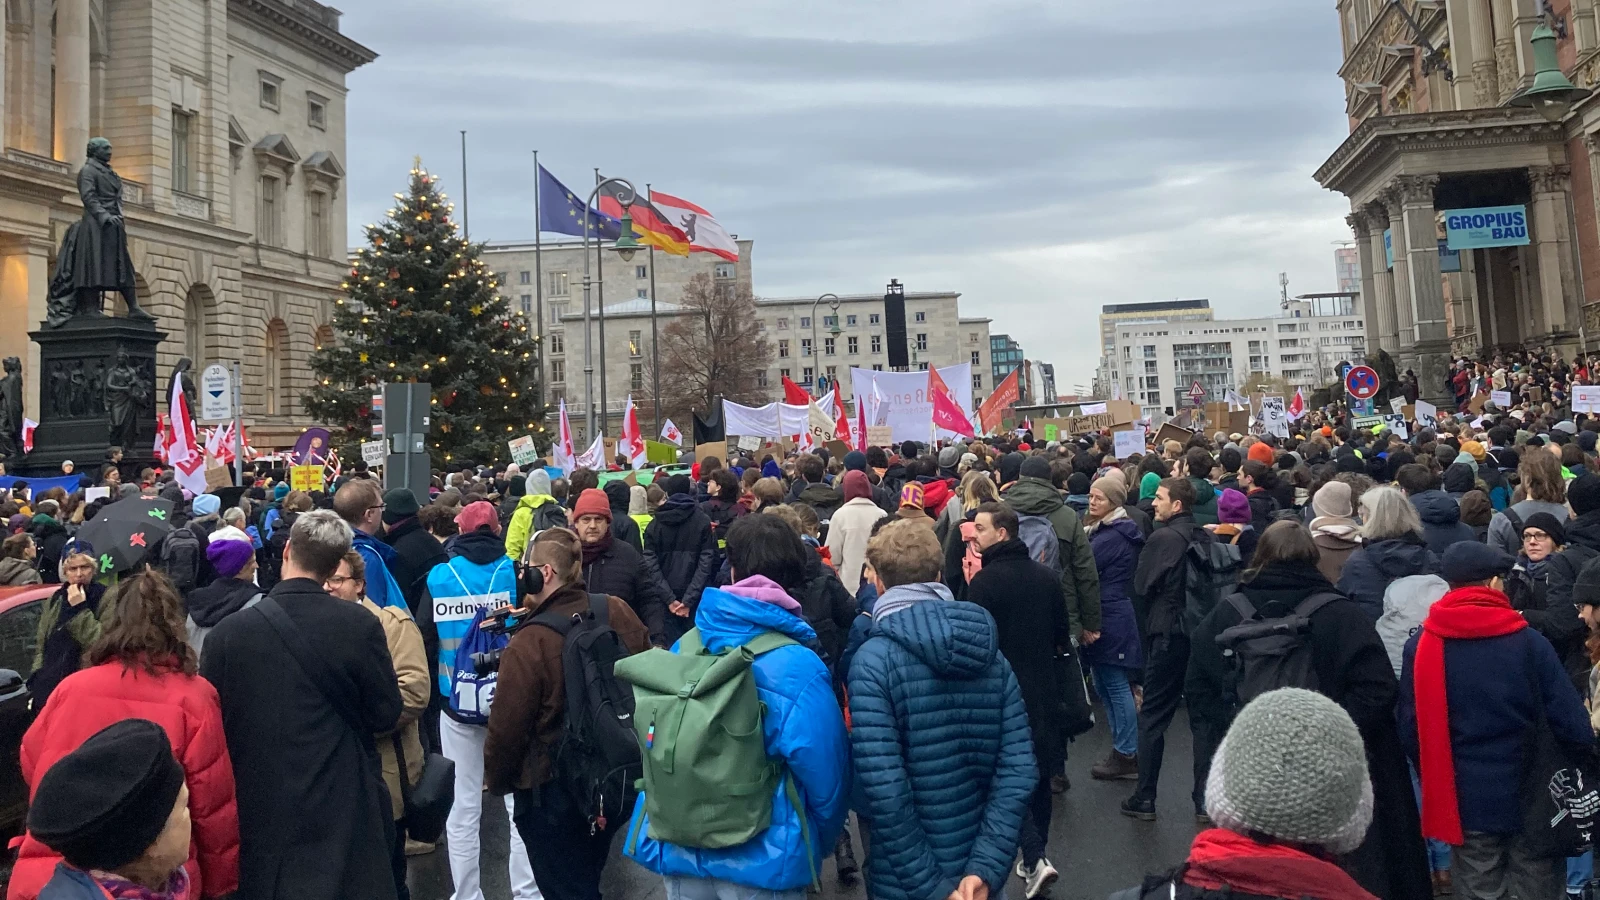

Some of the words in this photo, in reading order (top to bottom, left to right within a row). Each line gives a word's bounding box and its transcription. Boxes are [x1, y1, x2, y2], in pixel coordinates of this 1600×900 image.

[1448, 211, 1524, 230] GROPIUS
[1491, 226, 1526, 239] BAU
[212, 367, 220, 375] 30
